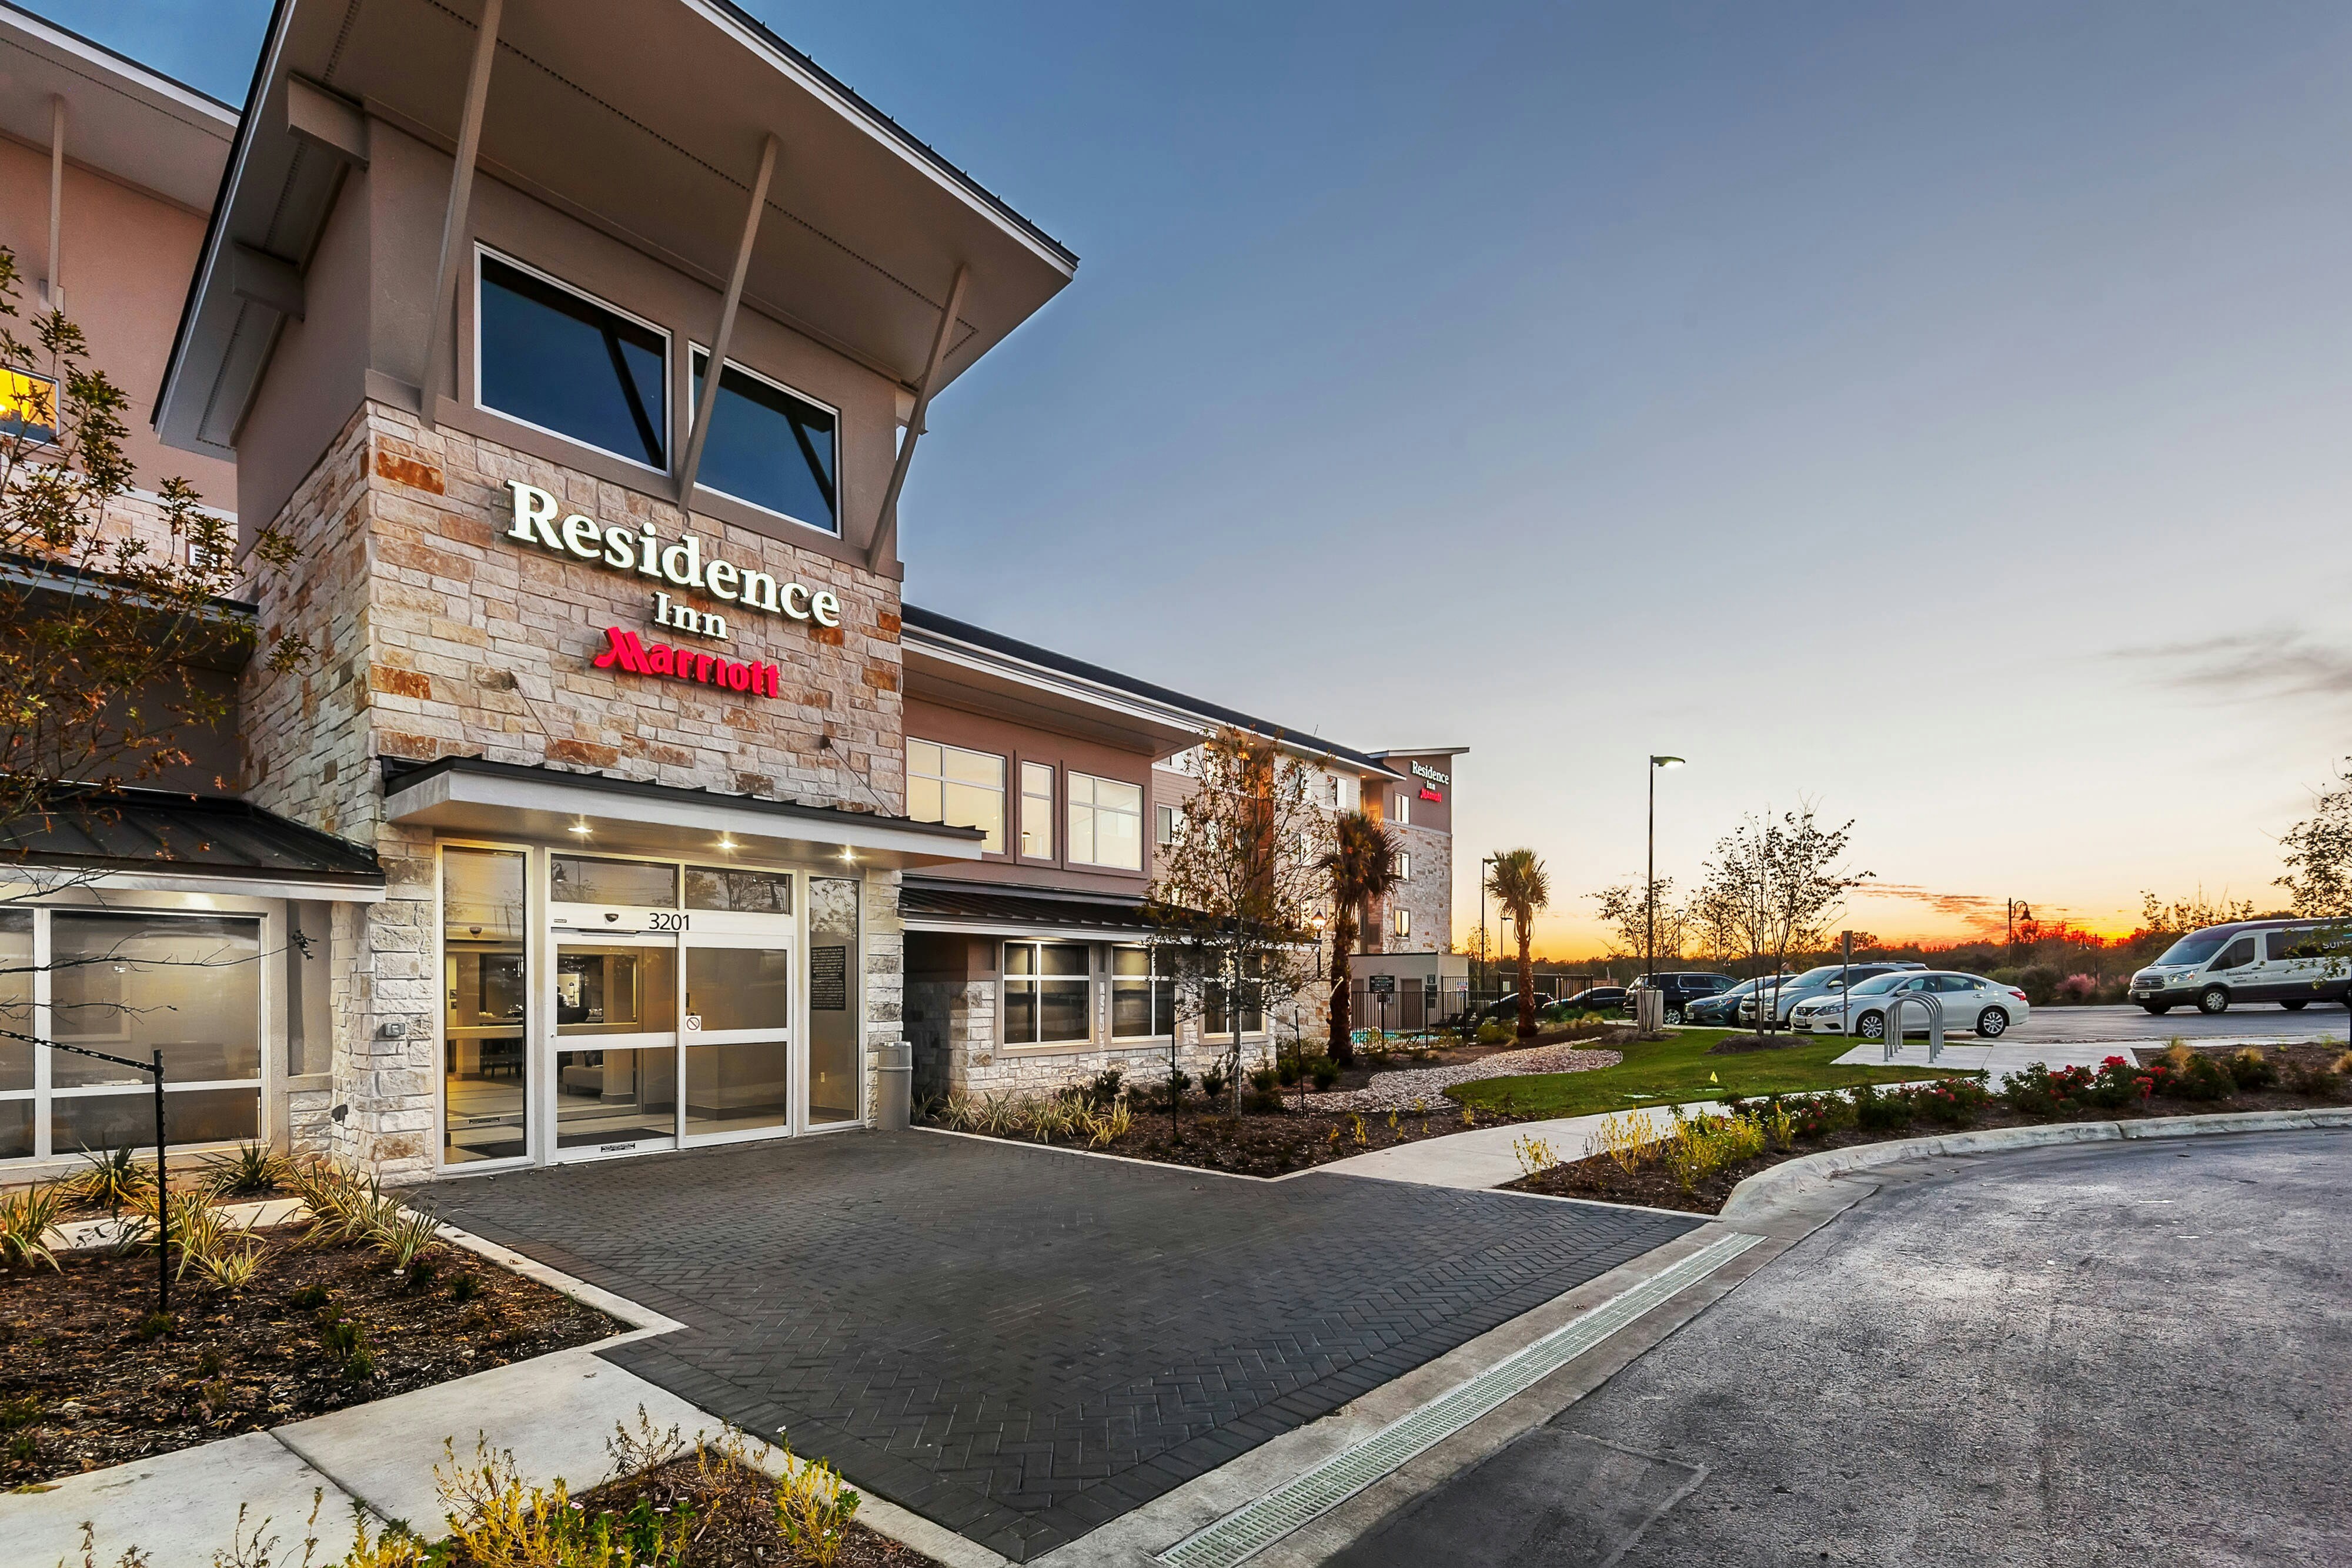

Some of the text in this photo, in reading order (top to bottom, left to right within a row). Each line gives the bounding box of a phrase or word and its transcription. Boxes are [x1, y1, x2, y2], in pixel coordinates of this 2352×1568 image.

[505, 479, 840, 627] Residence
[652, 591, 729, 640] Inn
[593, 626, 780, 698] Marriott
[1412, 760, 1449, 785] Residence
[1426, 780, 1436, 790] Inn
[649, 913, 689, 931] 3201
